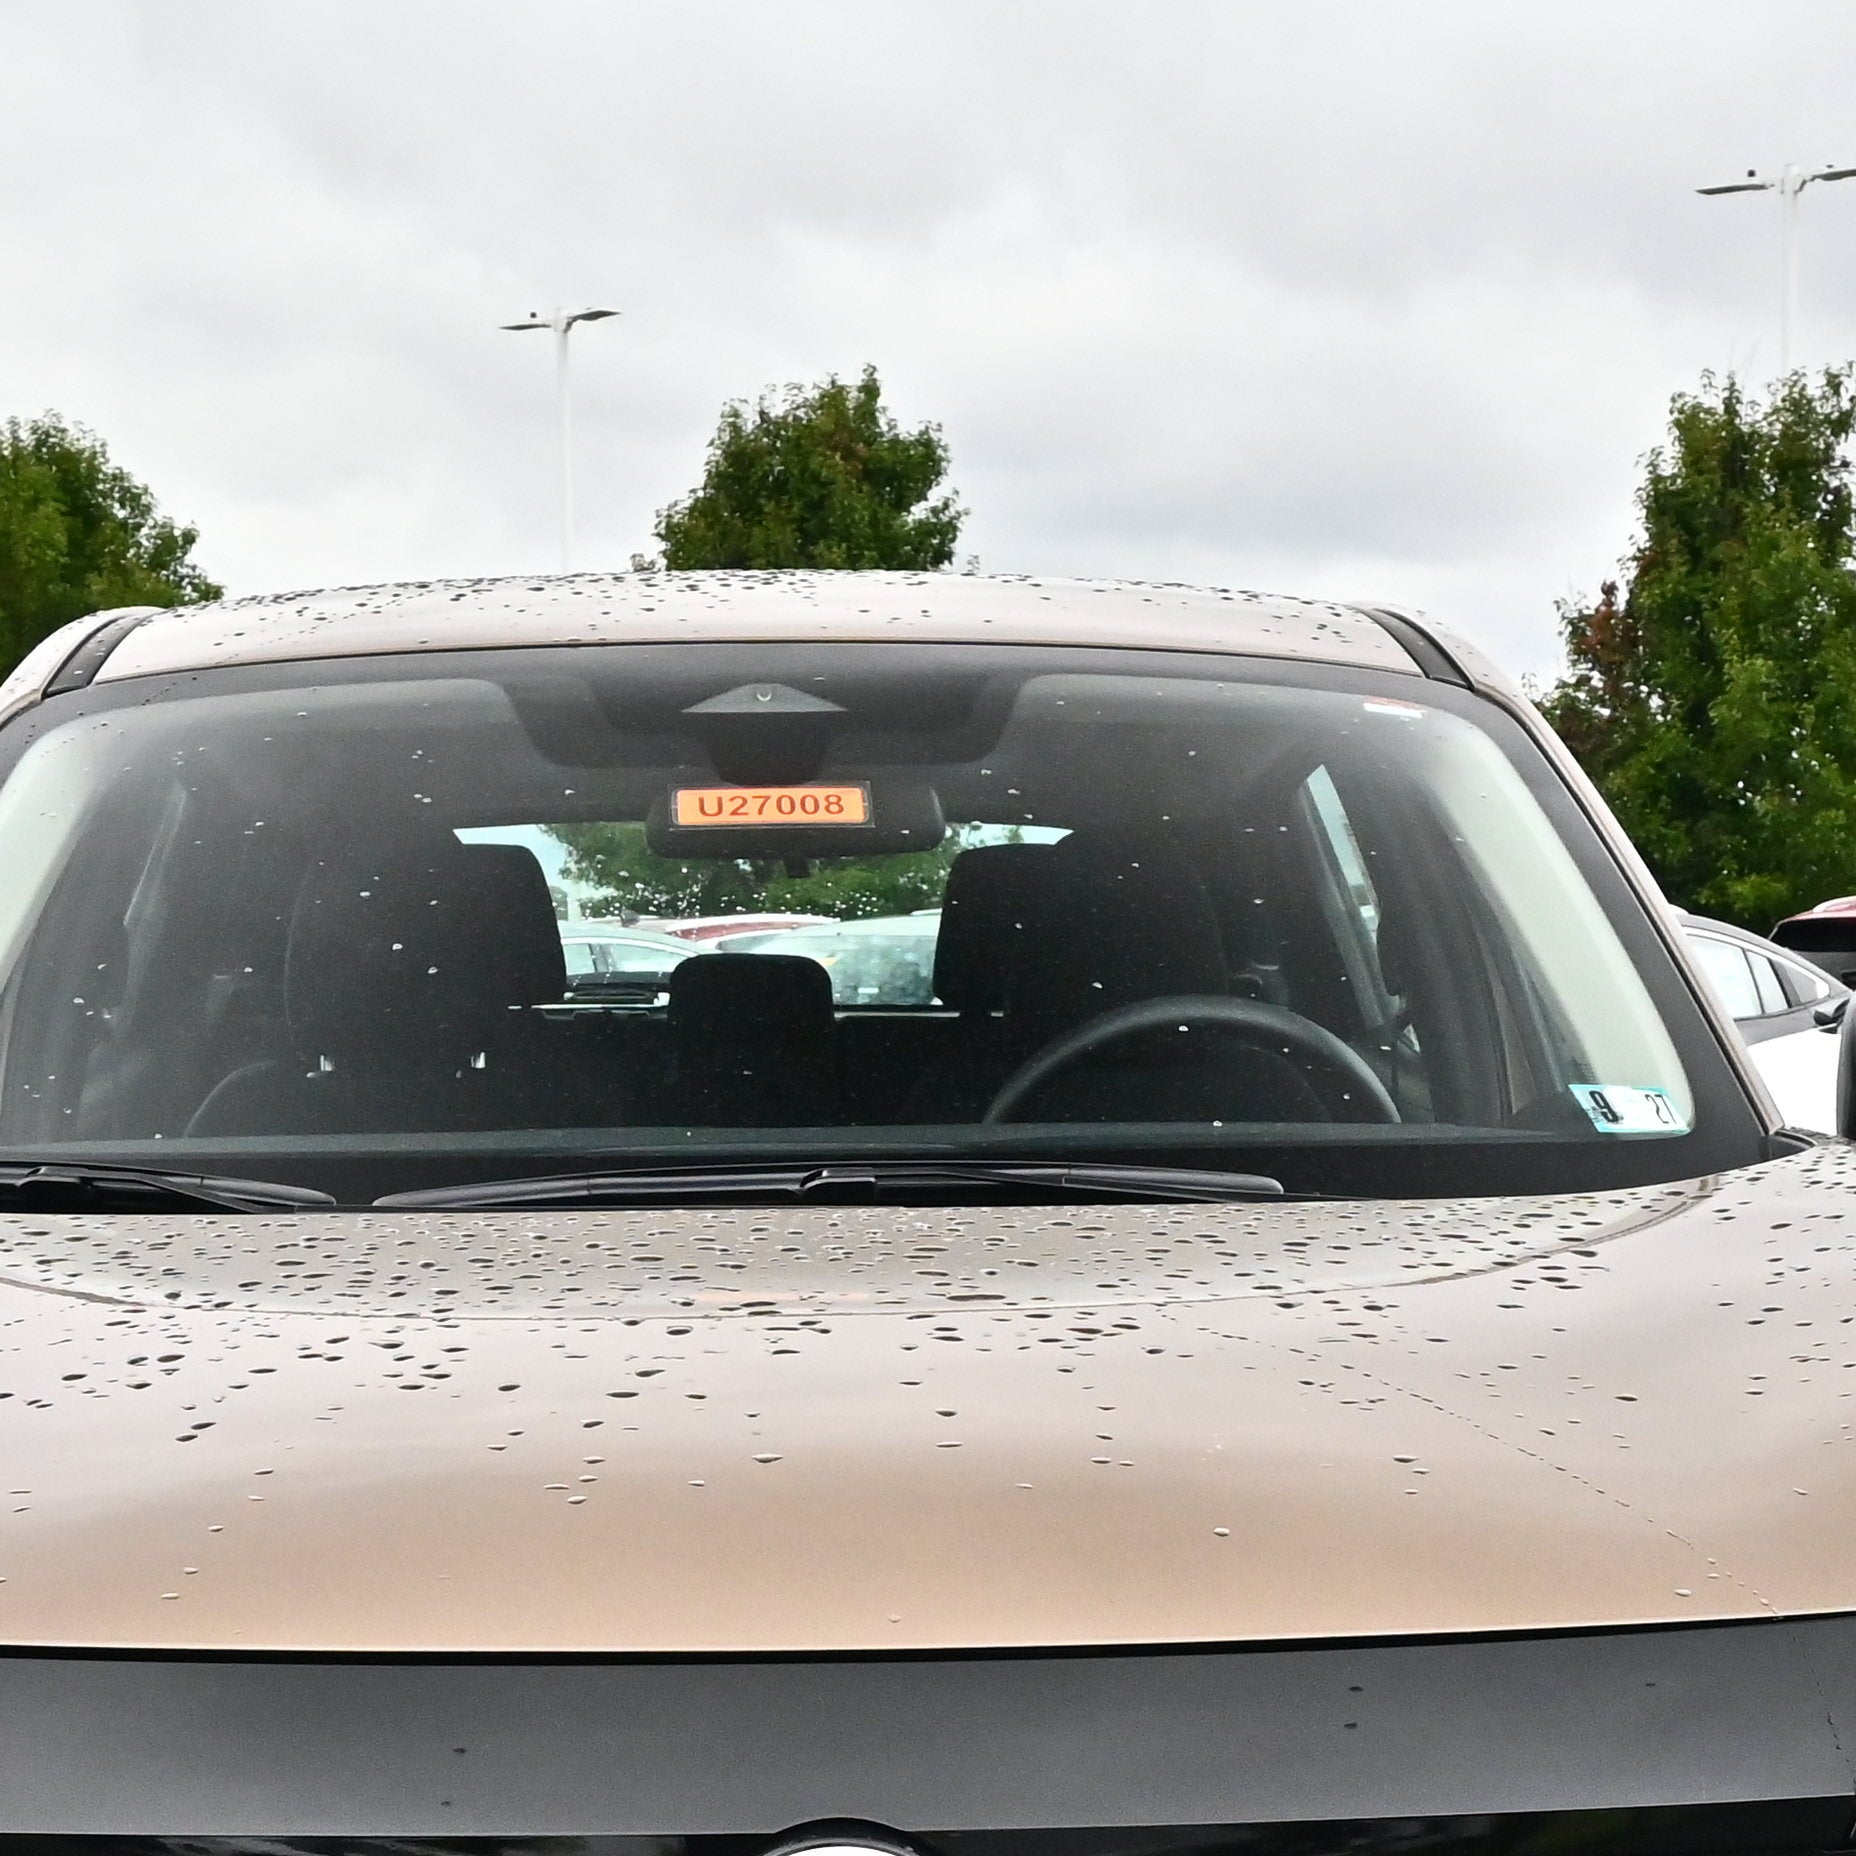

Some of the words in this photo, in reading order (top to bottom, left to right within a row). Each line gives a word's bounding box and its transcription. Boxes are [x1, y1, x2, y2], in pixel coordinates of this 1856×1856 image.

[698, 794, 845, 818] U27008
[1589, 1090, 1619, 1123] 9
[1644, 1094, 1677, 1125] 27
